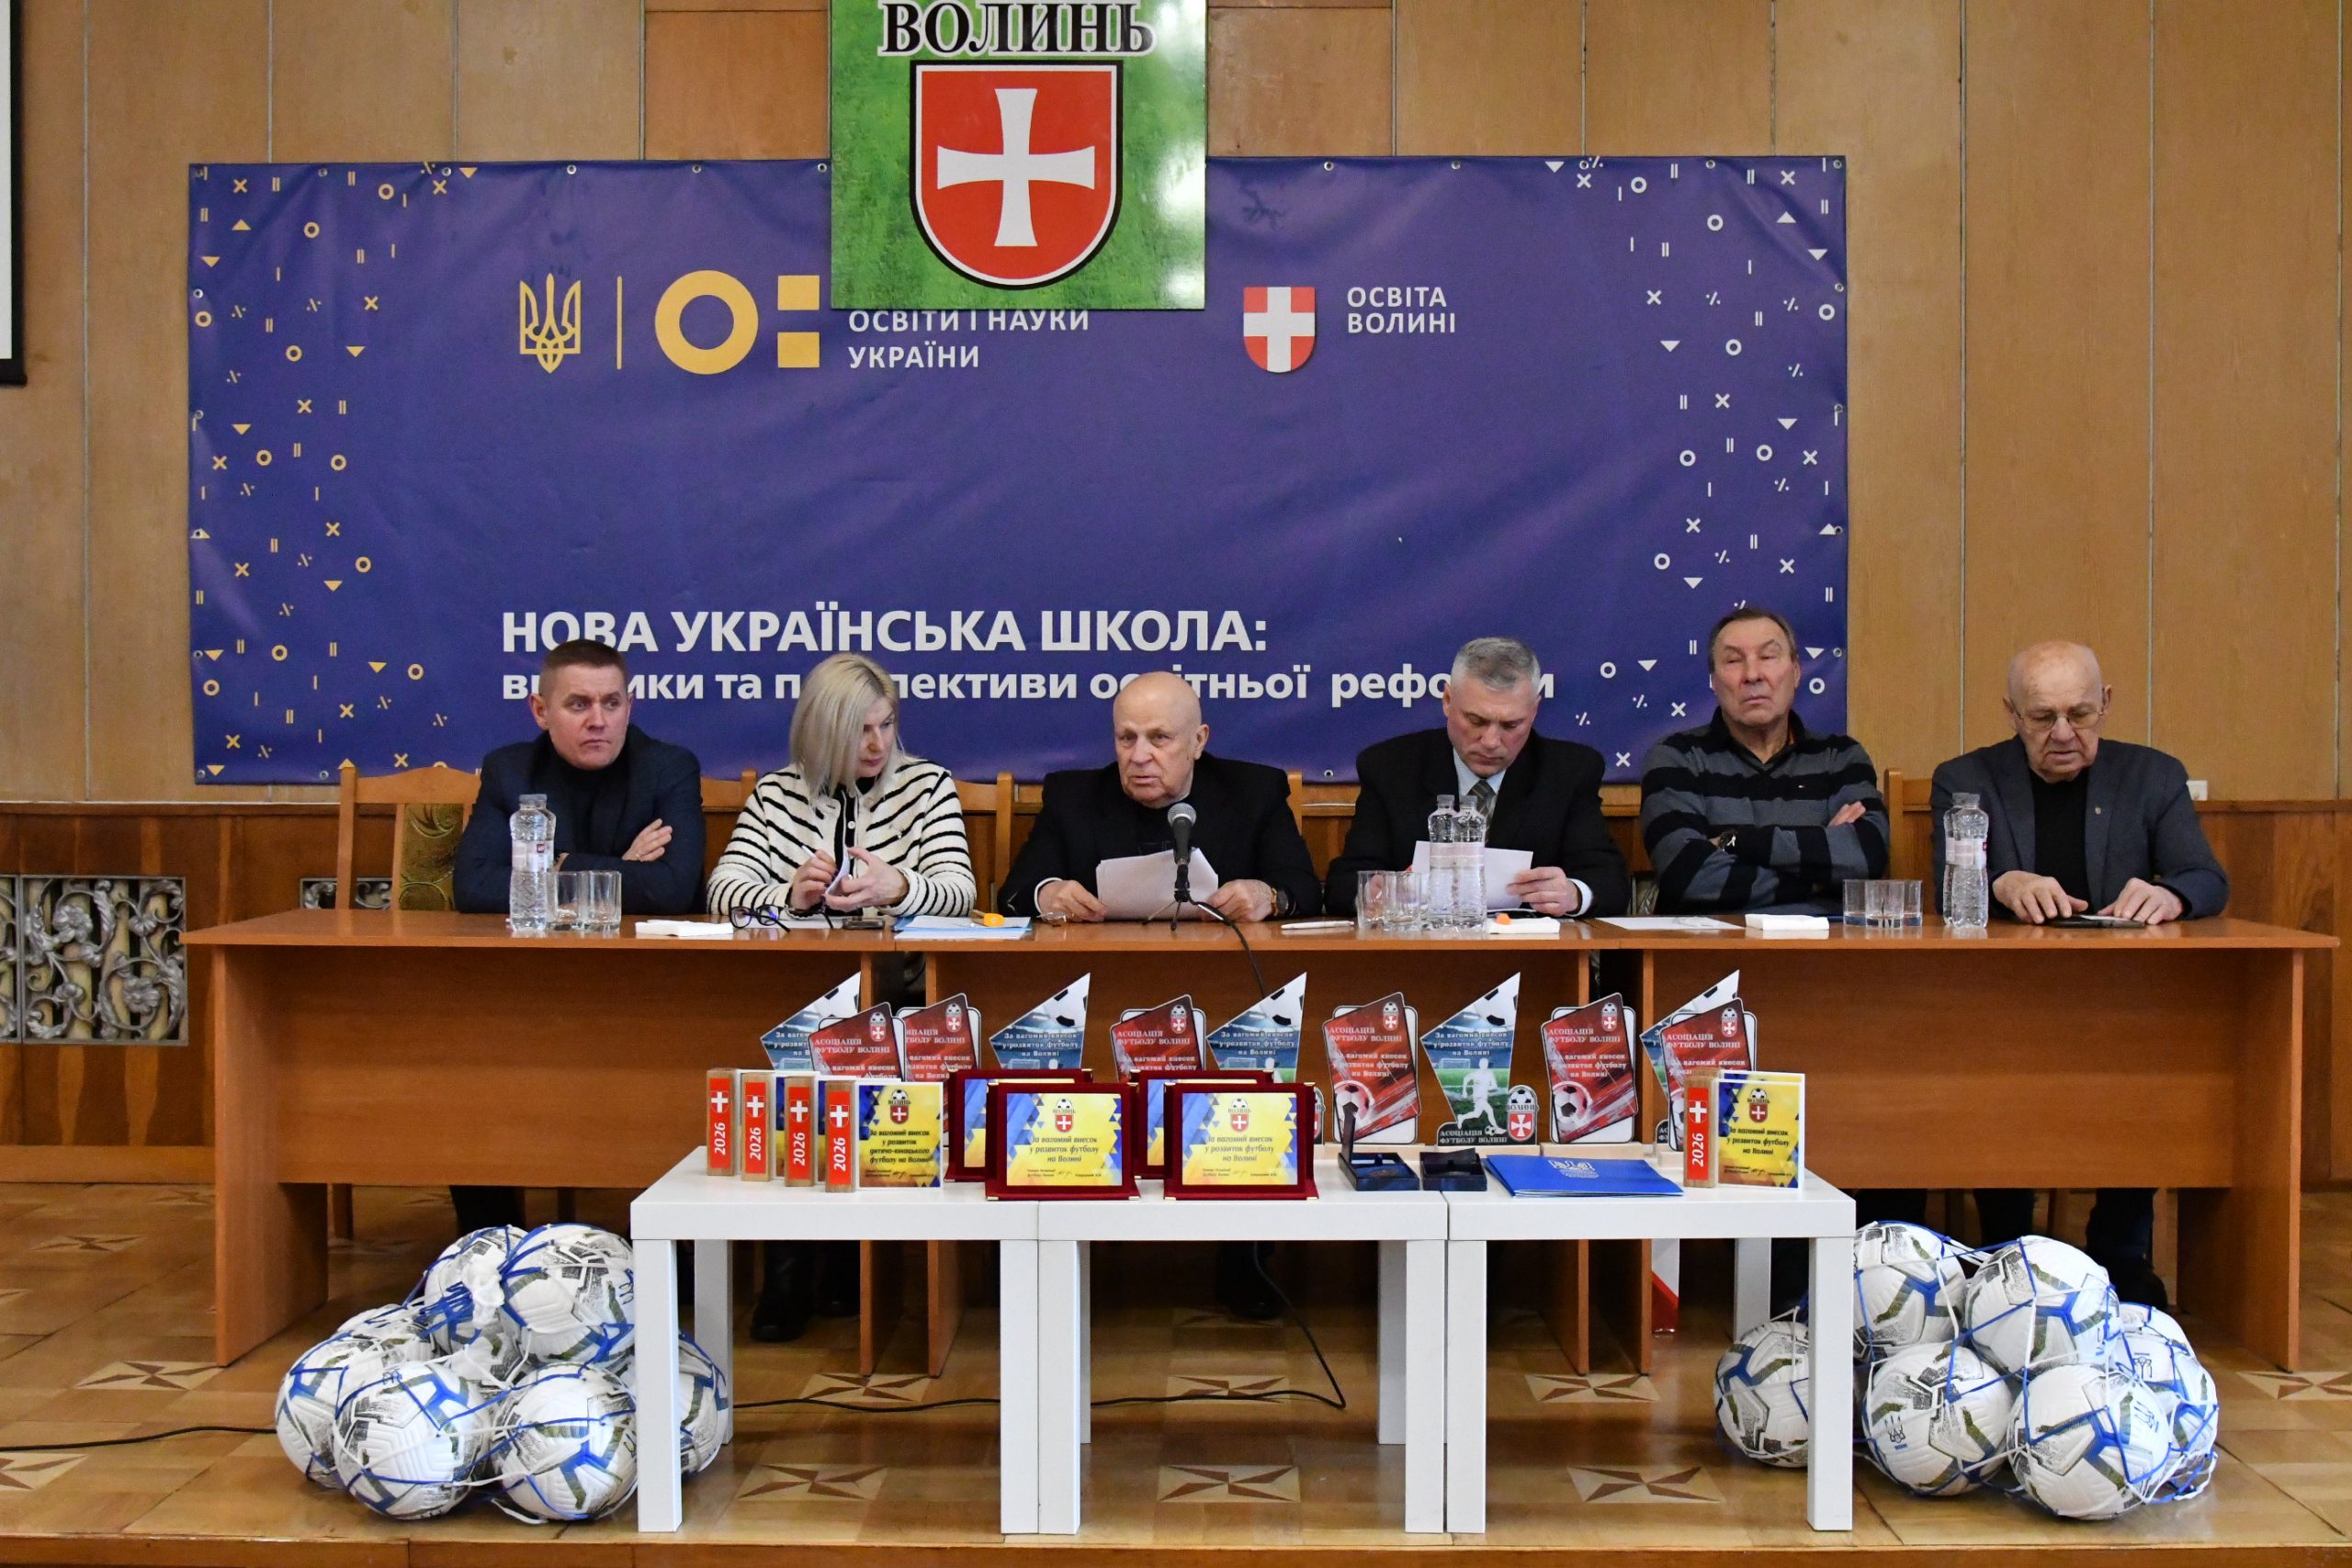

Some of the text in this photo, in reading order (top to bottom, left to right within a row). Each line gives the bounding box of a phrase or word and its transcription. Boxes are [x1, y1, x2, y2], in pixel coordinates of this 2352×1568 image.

[877, 0, 1157, 56] ВОЛИНЬ
[1347, 287, 1447, 308] ОСВІТА
[848, 310, 1090, 333] ОСВІТИ І НАУКИ
[1347, 312, 1456, 333] ВОЛИНІ
[848, 340, 979, 368] УКРАЇНИ
[503, 602, 1267, 652] НОВА УКРАЇНСЬКА ШКОЛА:
[716, 673, 768, 700] та
[775, 673, 1077, 700] ппективи
[1331, 663, 1554, 707] рефои
[714, 1122, 727, 1156] 2026
[750, 1126, 762, 1161] 2026
[793, 1132, 806, 1166] 2026
[833, 1137, 846, 1172] 2026
[1691, 1132, 1705, 1168] 2026
